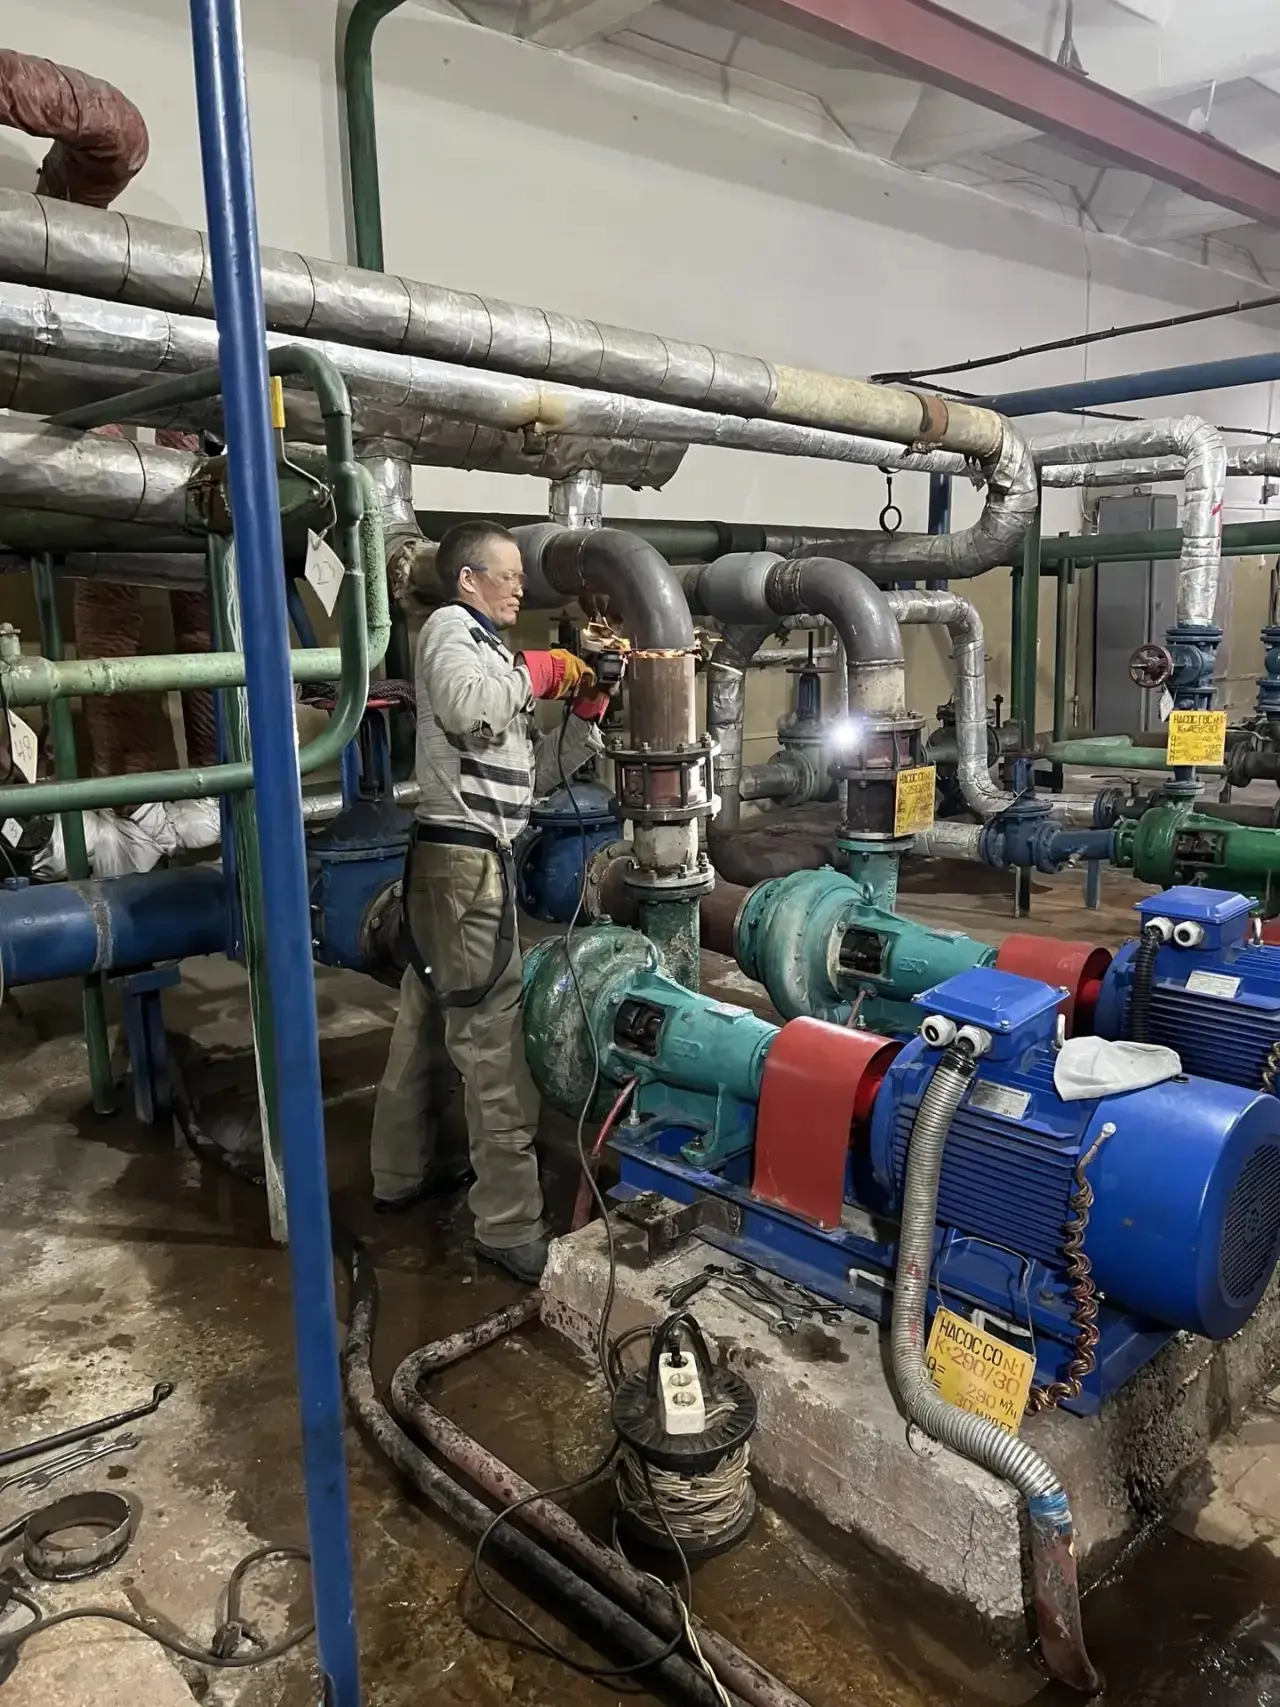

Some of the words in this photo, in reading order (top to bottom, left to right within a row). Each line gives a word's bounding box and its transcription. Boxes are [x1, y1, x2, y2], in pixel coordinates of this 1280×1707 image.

[940, 1318, 983, 1355] НАСОС
[982, 1344, 1003, 1367] СО
[965, 1383, 997, 1410] 290
